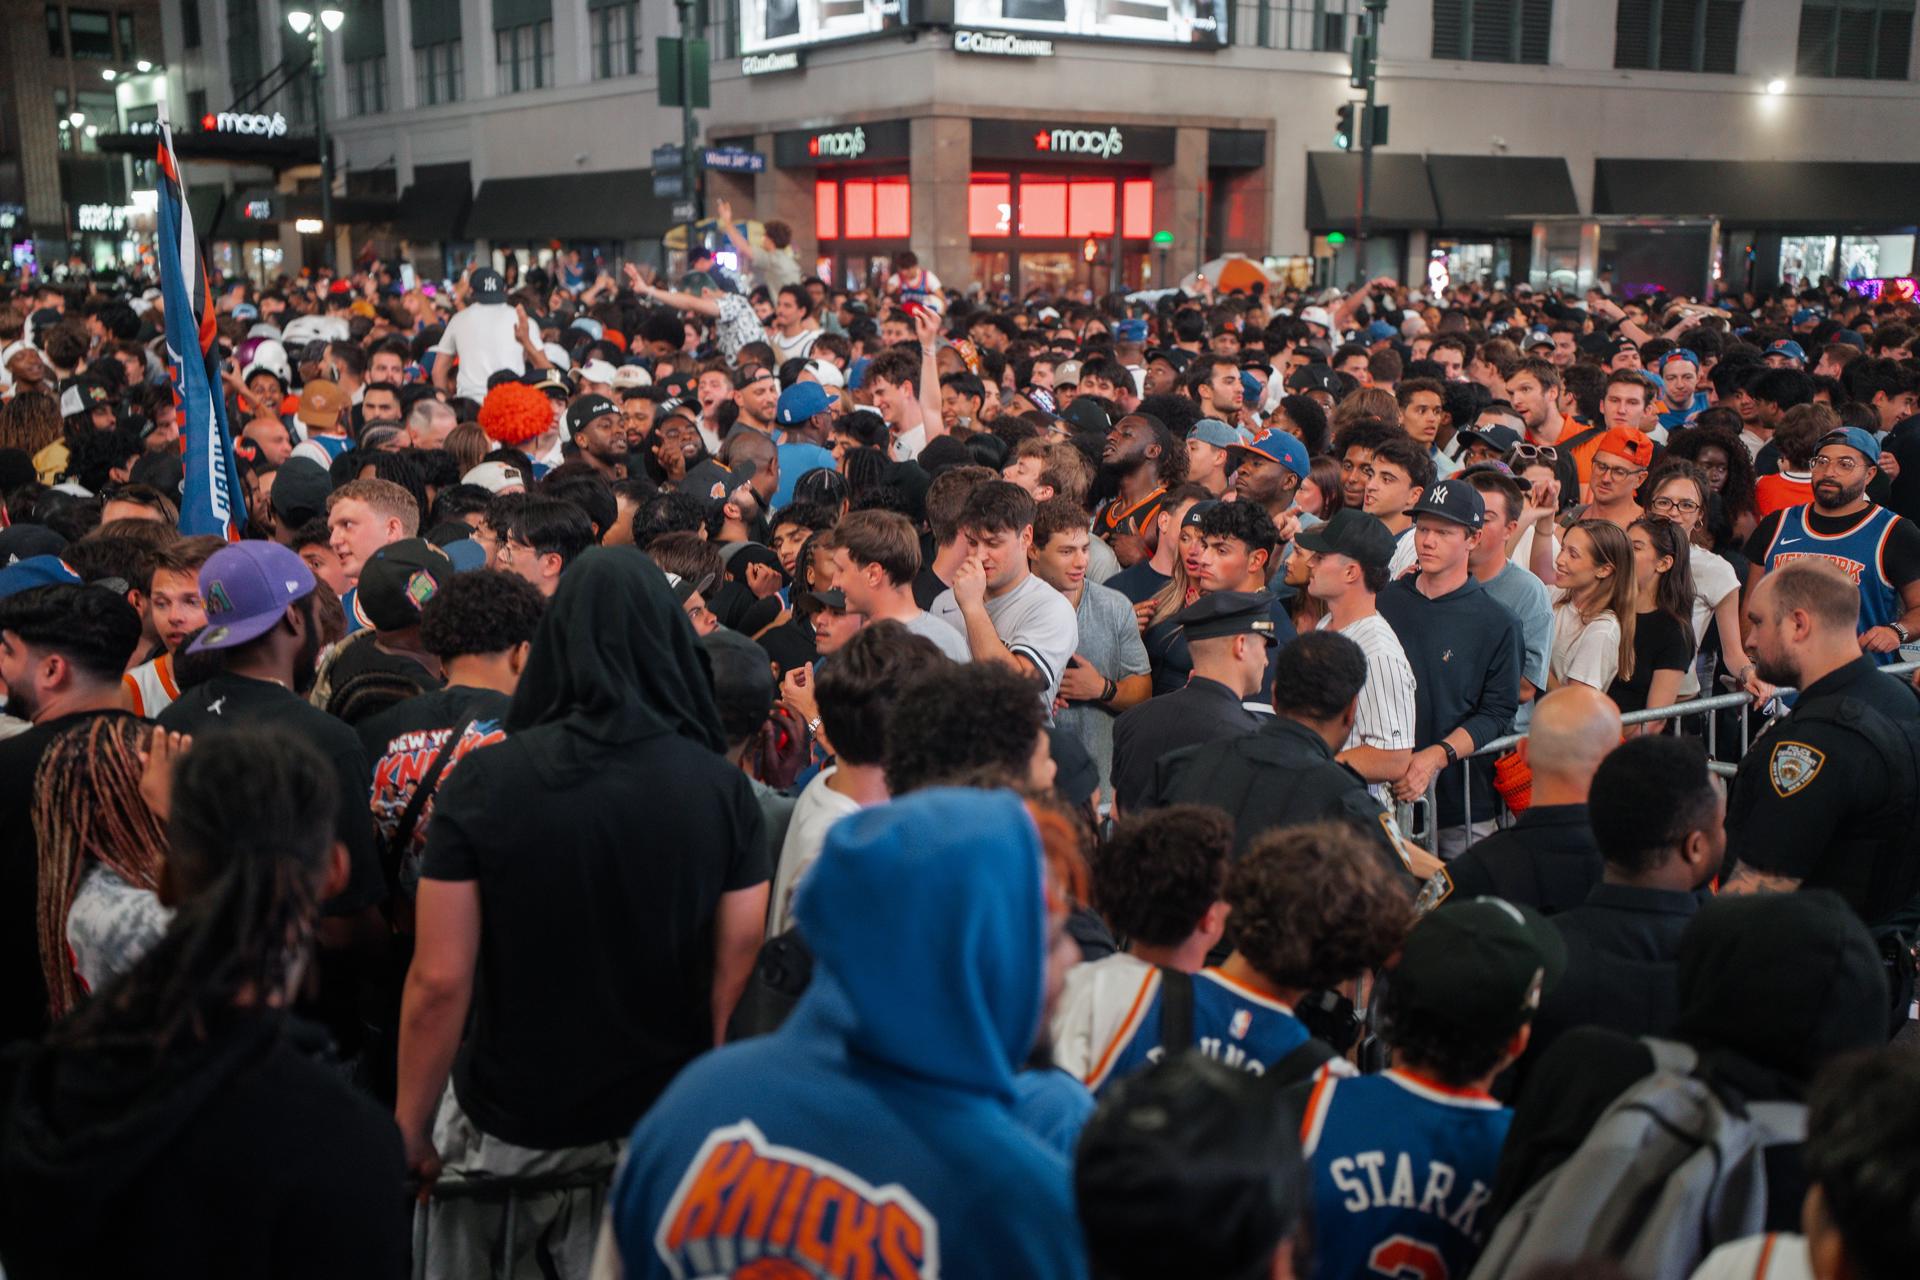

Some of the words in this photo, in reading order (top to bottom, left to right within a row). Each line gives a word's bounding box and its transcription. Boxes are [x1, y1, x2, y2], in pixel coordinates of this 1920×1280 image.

[1051, 127, 1123, 159] macy's
[388, 732, 426, 753] NEW
[665, 1138, 924, 1280] KNICKS
[1330, 1150, 1492, 1243] STARK
